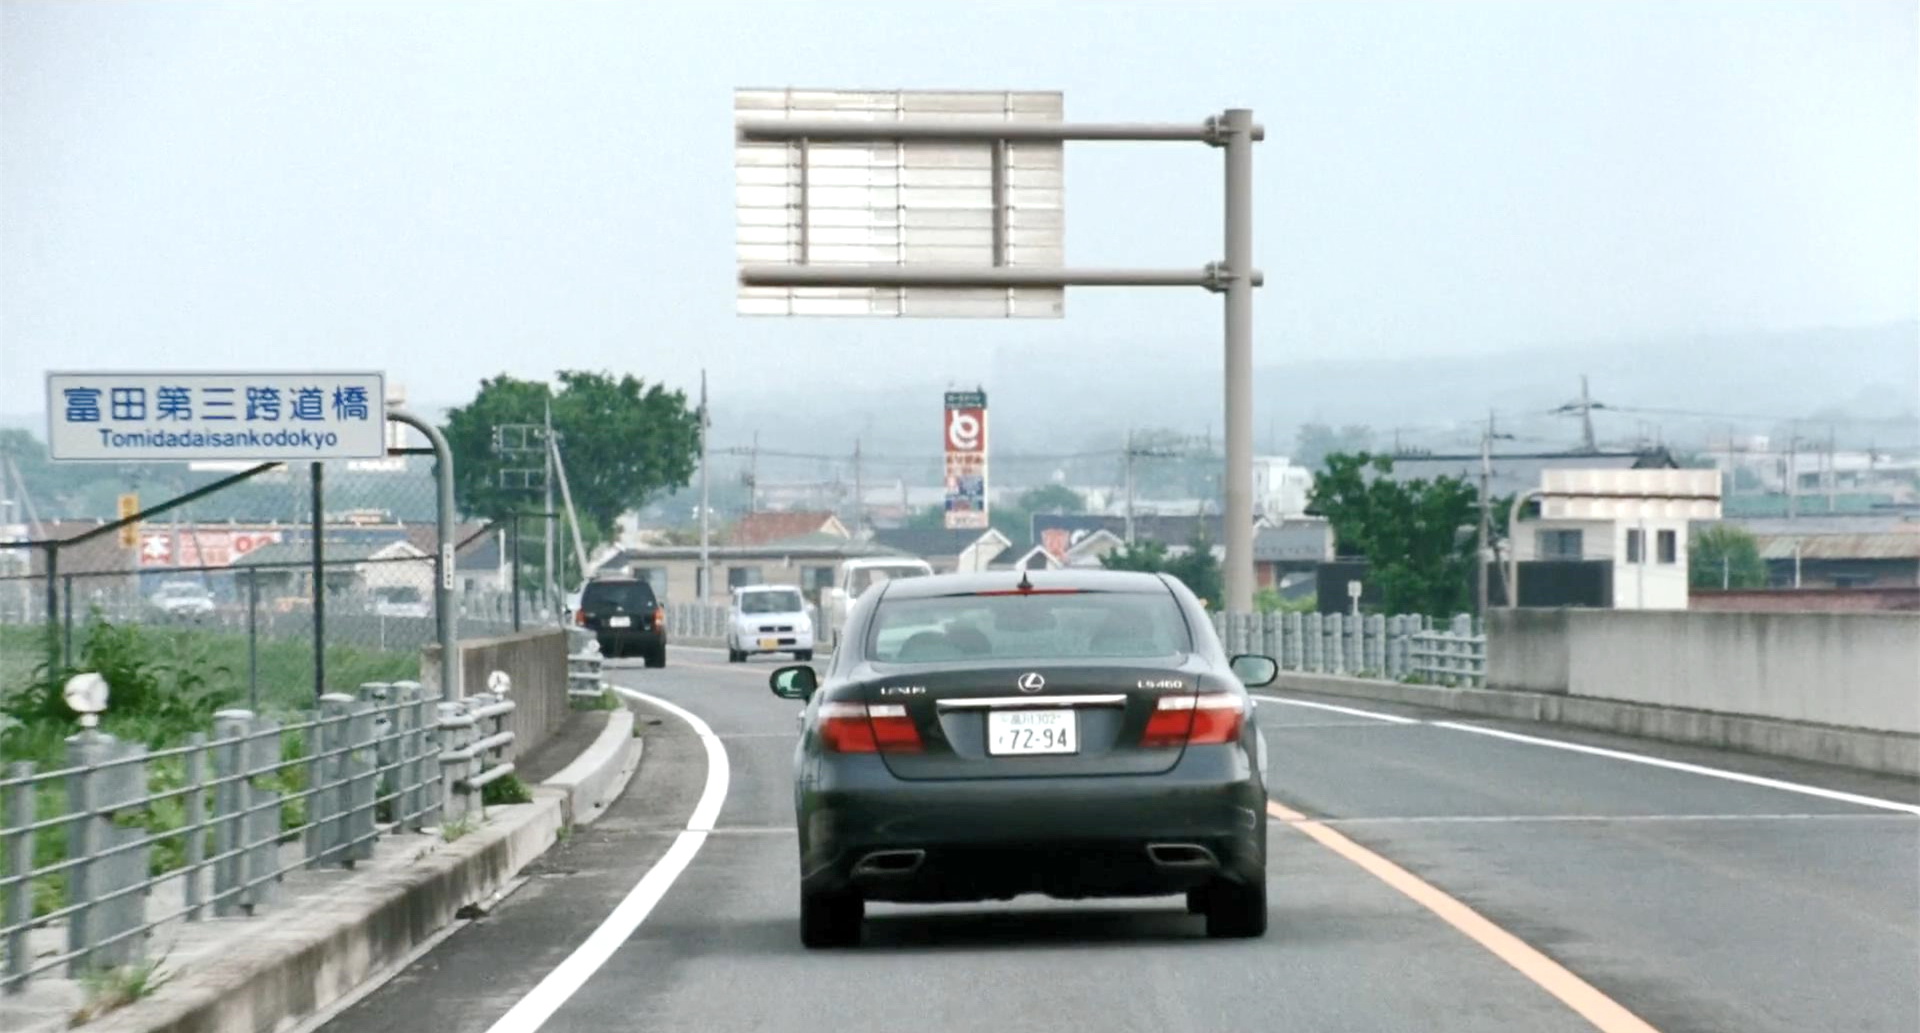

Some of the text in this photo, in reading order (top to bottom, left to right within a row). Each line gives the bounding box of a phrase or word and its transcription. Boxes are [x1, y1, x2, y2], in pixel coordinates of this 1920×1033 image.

[64, 386, 369, 423] 富田第三跨道橋
[98, 428, 338, 449] Tomidadaisankodokyo
[1010, 728, 1067, 750] 72-94
